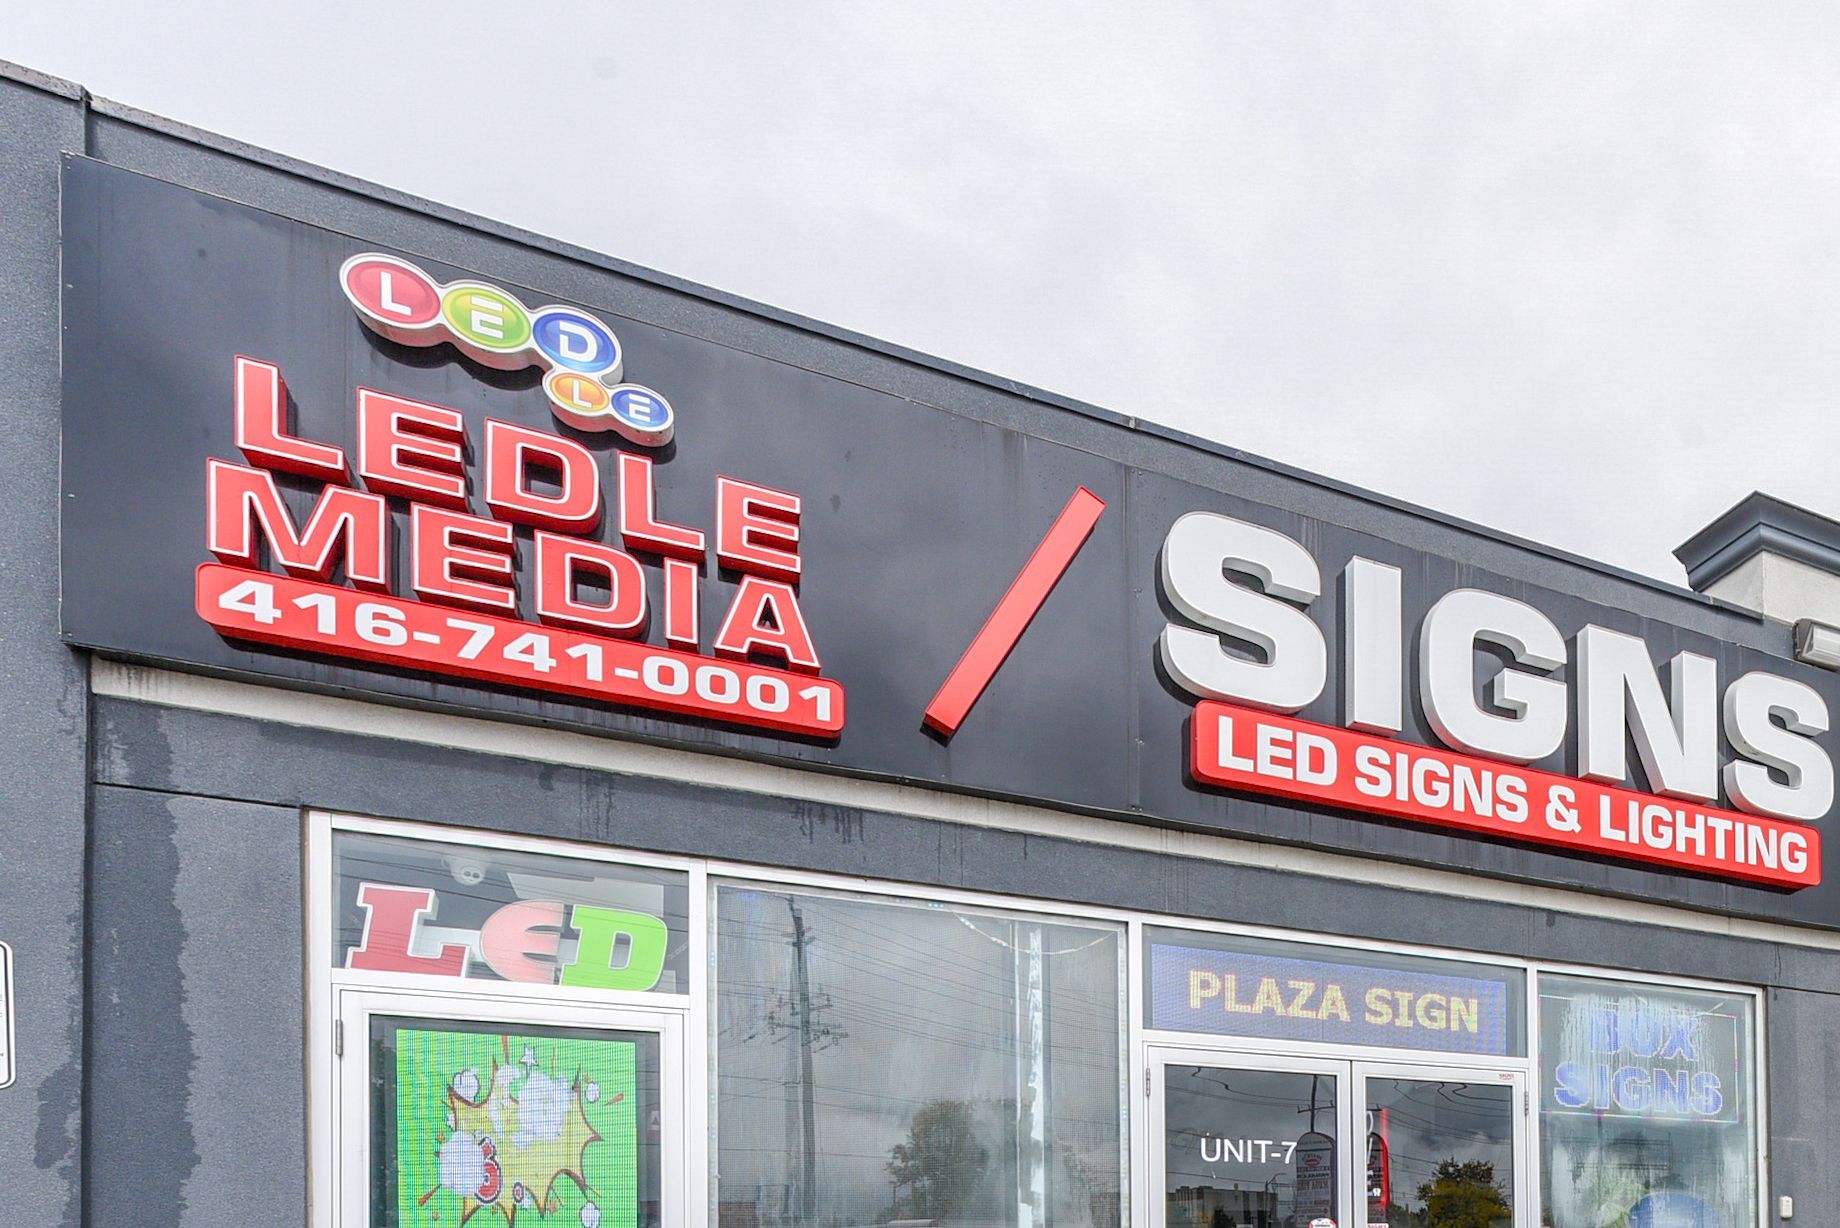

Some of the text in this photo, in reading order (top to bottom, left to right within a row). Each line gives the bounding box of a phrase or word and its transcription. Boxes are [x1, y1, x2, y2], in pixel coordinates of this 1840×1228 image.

[234, 355, 801, 581] LEDLE
[207, 456, 822, 674] MEDIA
[217, 580, 835, 723] 416-741-0001
[1159, 511, 1834, 821] SIGNS
[1216, 715, 1809, 874] LED SIGNS & LIGHTING
[346, 882, 668, 992] LED
[1188, 969, 1480, 1034] PLAZA SIGN
[1199, 1135, 1298, 1166] UNIT-7
[1553, 1062, 1723, 1116] SIGNS
